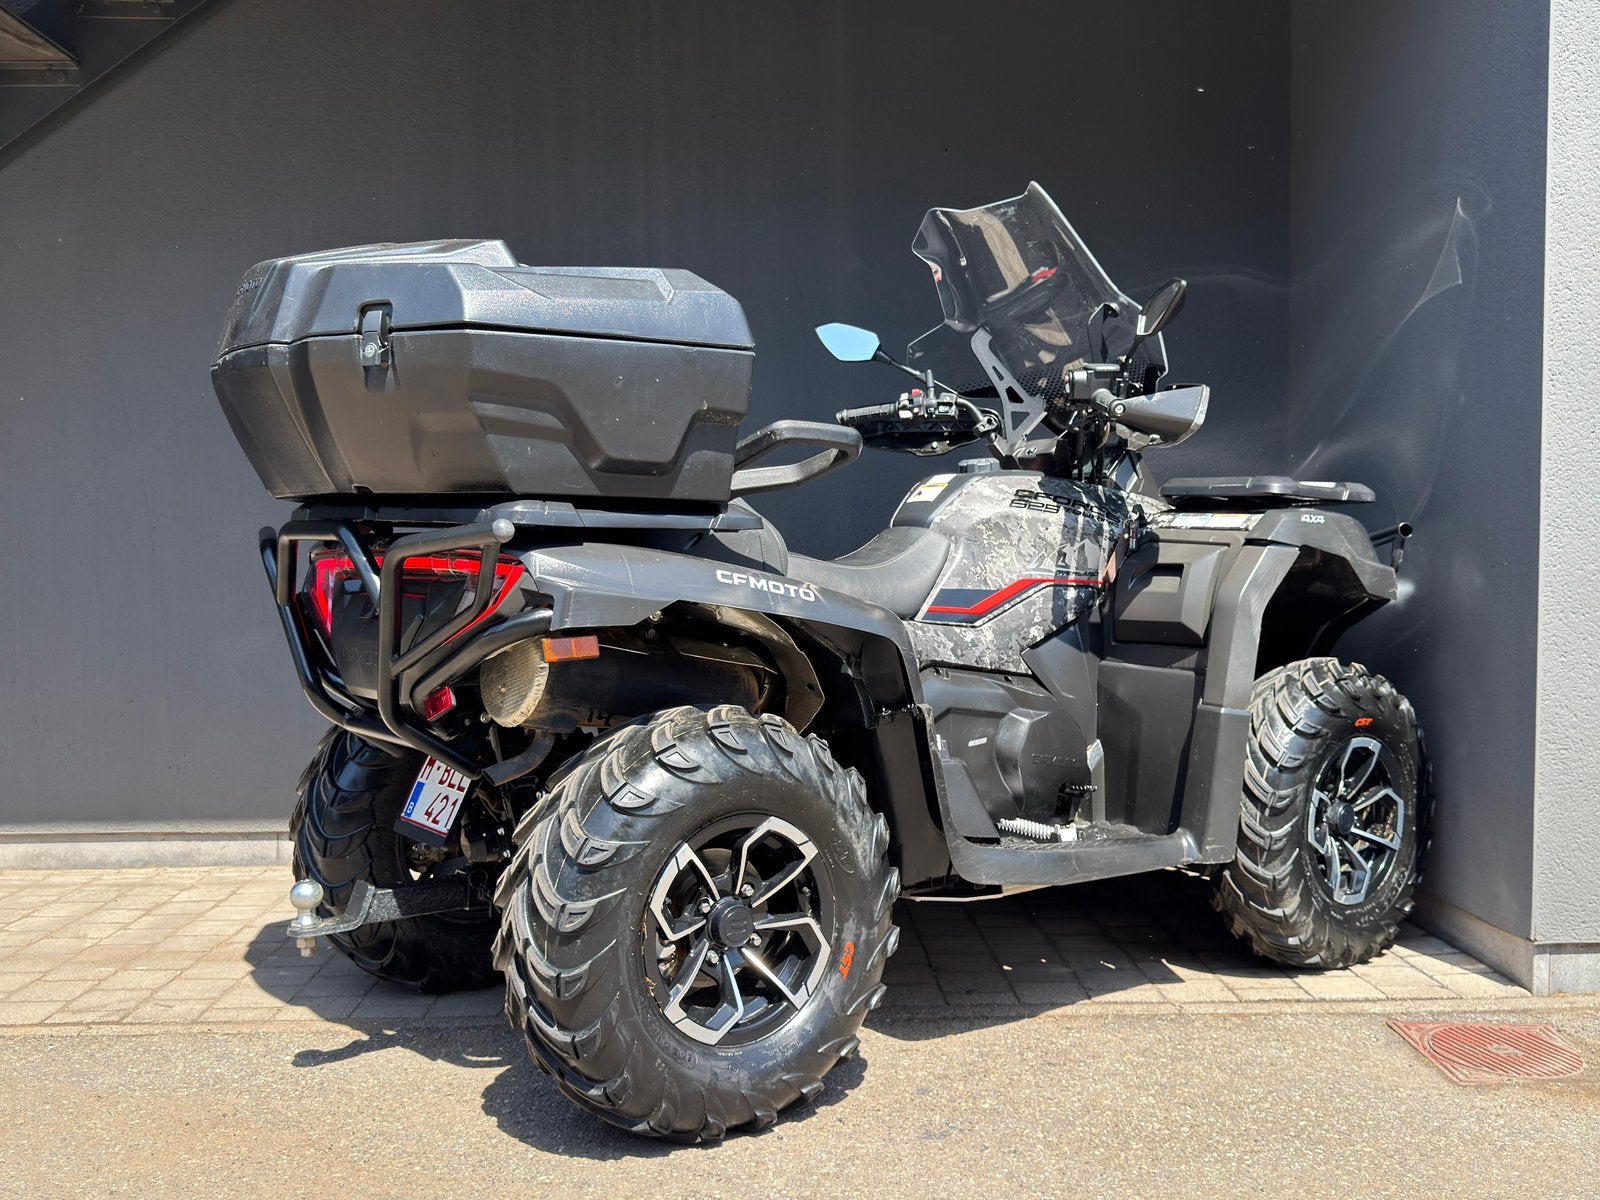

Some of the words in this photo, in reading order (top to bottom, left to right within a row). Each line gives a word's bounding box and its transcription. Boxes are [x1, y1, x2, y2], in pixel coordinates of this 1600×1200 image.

[1009, 498, 1061, 514] 625
[1014, 489, 1121, 523] CFORCE
[716, 569, 815, 602] CFMOTO
[1355, 718, 1373, 727] CST
[407, 803, 414, 813] B
[424, 792, 459, 828] 421
[839, 942, 854, 980] CST
